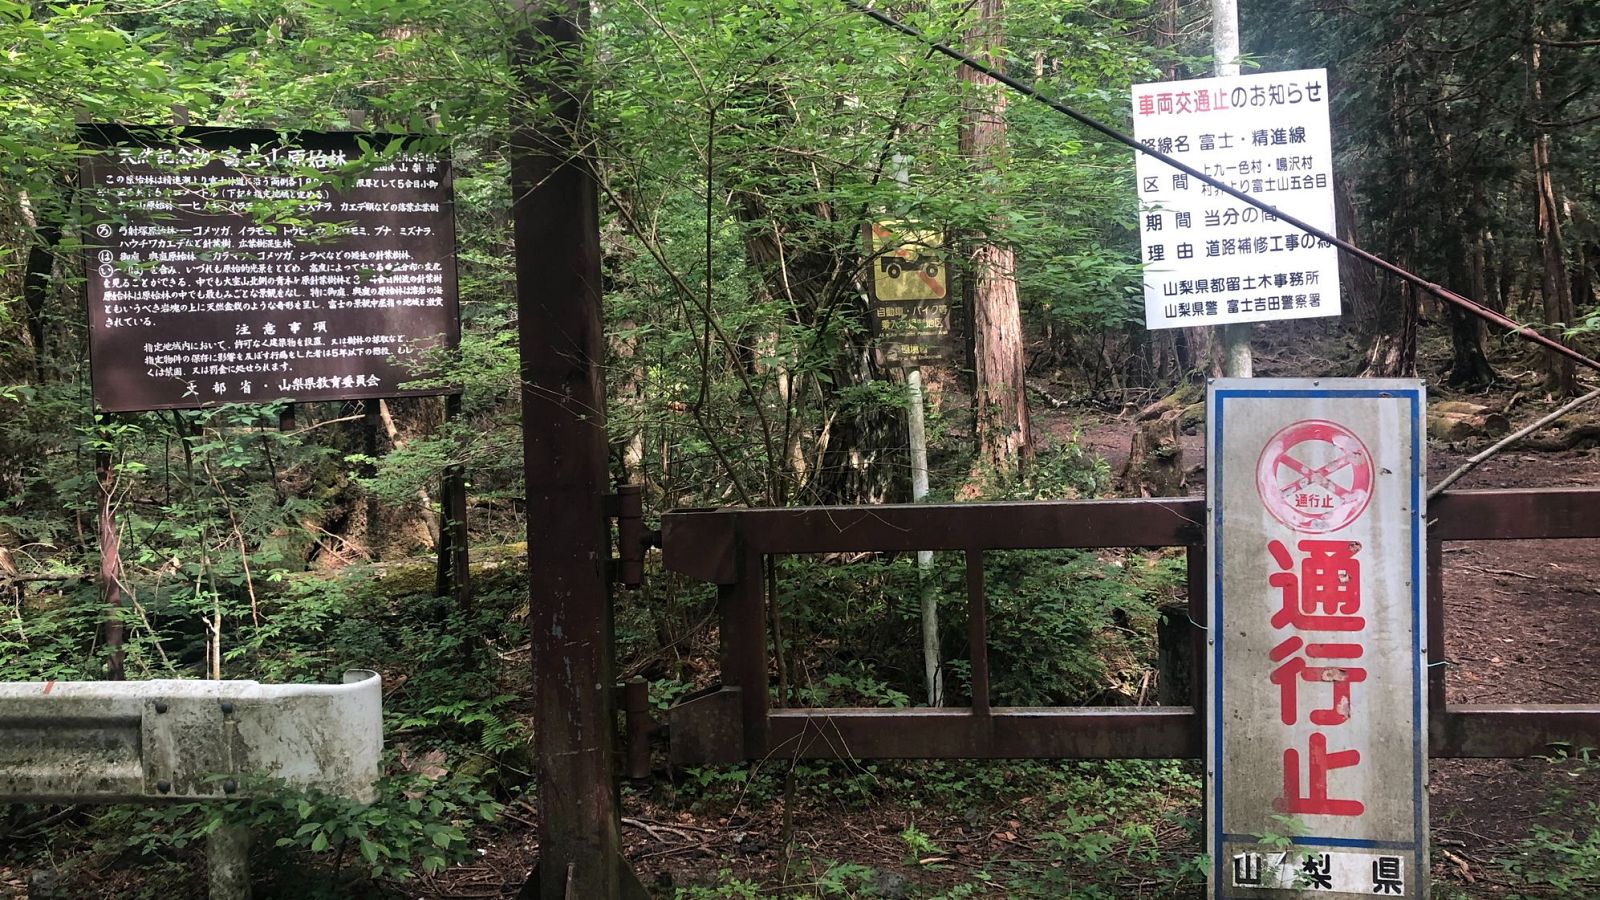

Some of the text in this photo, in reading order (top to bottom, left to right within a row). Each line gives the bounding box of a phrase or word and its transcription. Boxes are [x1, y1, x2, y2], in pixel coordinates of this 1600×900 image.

[1138, 81, 1321, 117] 車両交通止のお知らせ
[1199, 126, 1306, 150] 富士・精進線
[1163, 271, 1320, 297] 山梨県都留土木事務所
[1164, 293, 1321, 319] 山梨県警 富士吉田警察署
[1295, 494, 1334, 509] 通行止
[1267, 540, 1367, 816] 通行止
